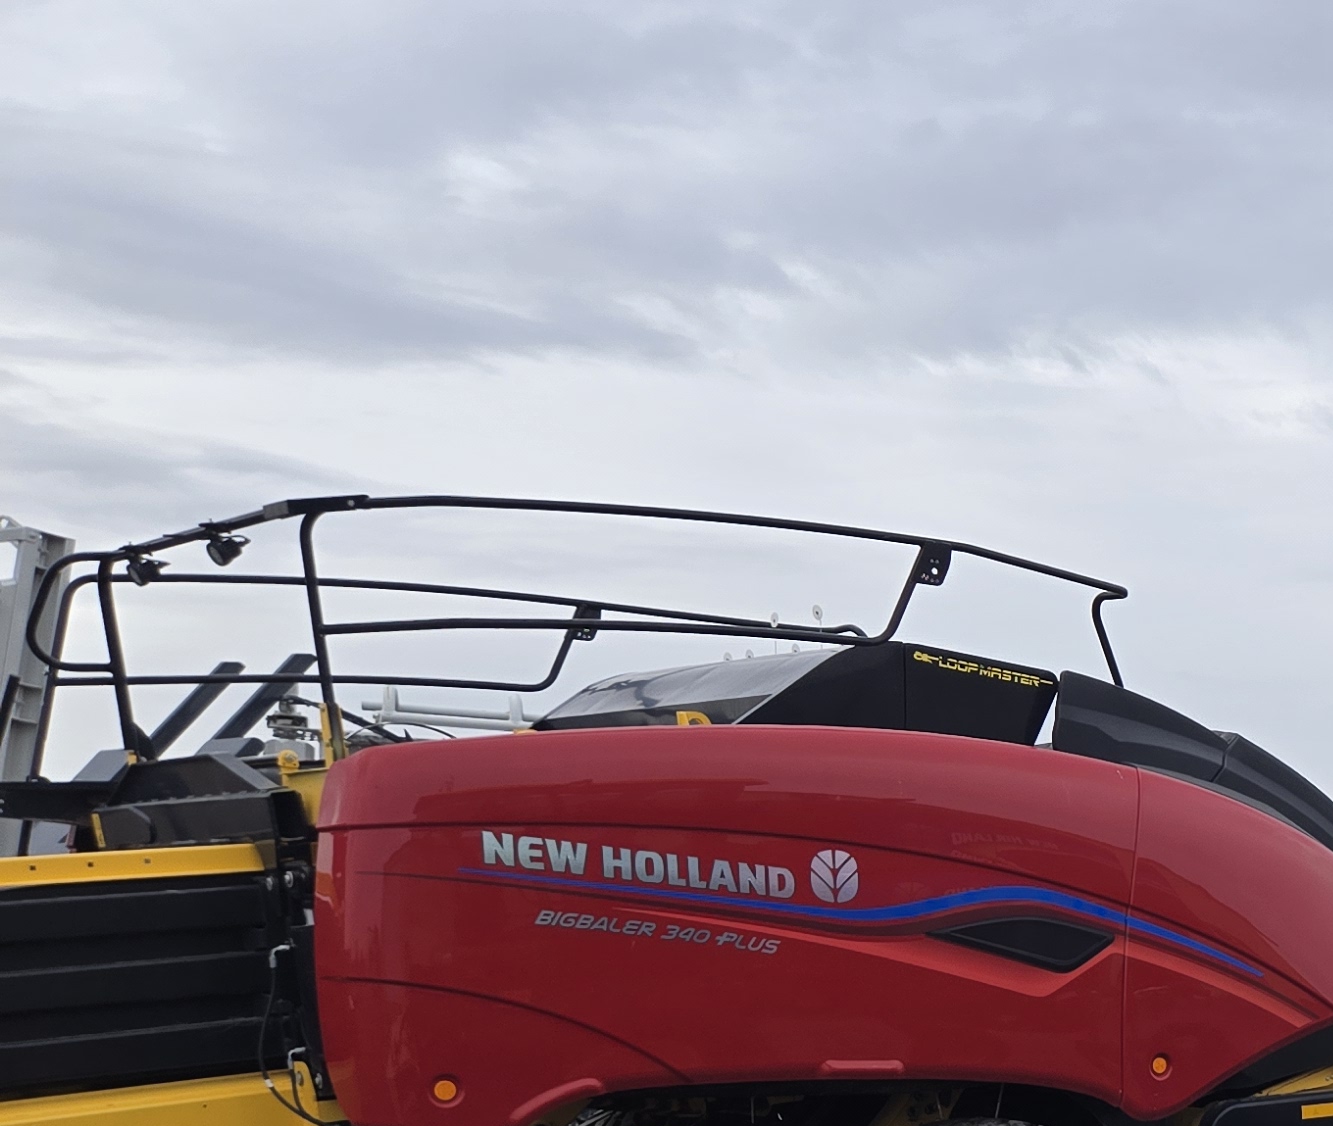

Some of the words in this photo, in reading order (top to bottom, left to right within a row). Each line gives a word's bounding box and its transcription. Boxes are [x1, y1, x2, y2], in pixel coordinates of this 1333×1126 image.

[481, 831, 588, 874] NEW
[601, 845, 796, 899] HOLLAND
[535, 910, 657, 937] BIGBALER
[661, 925, 711, 944] 340
